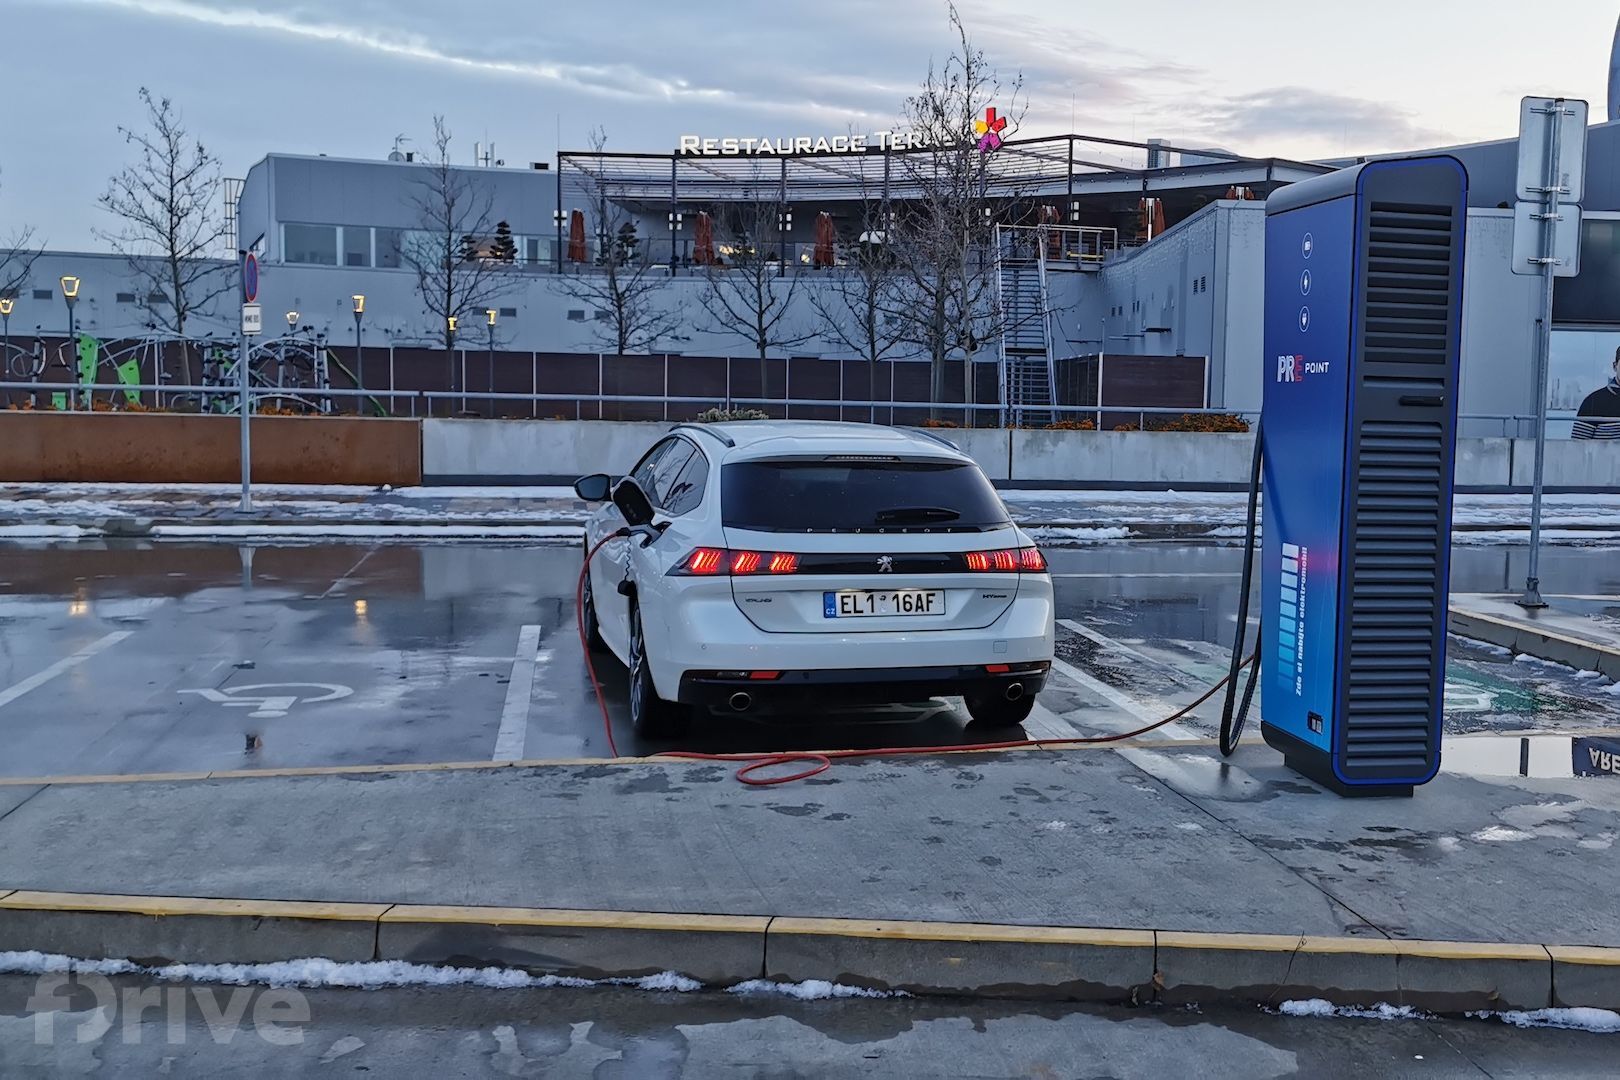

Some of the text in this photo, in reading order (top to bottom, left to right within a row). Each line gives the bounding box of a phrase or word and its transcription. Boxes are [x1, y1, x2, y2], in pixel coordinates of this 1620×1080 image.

[680, 134, 867, 156] RESTAURACE
[1277, 355, 1330, 382] PRE POINT
[1299, 546, 1308, 619] elektromobil
[840, 593, 936, 614] EL1 16AF
[1297, 662, 1303, 674] si
